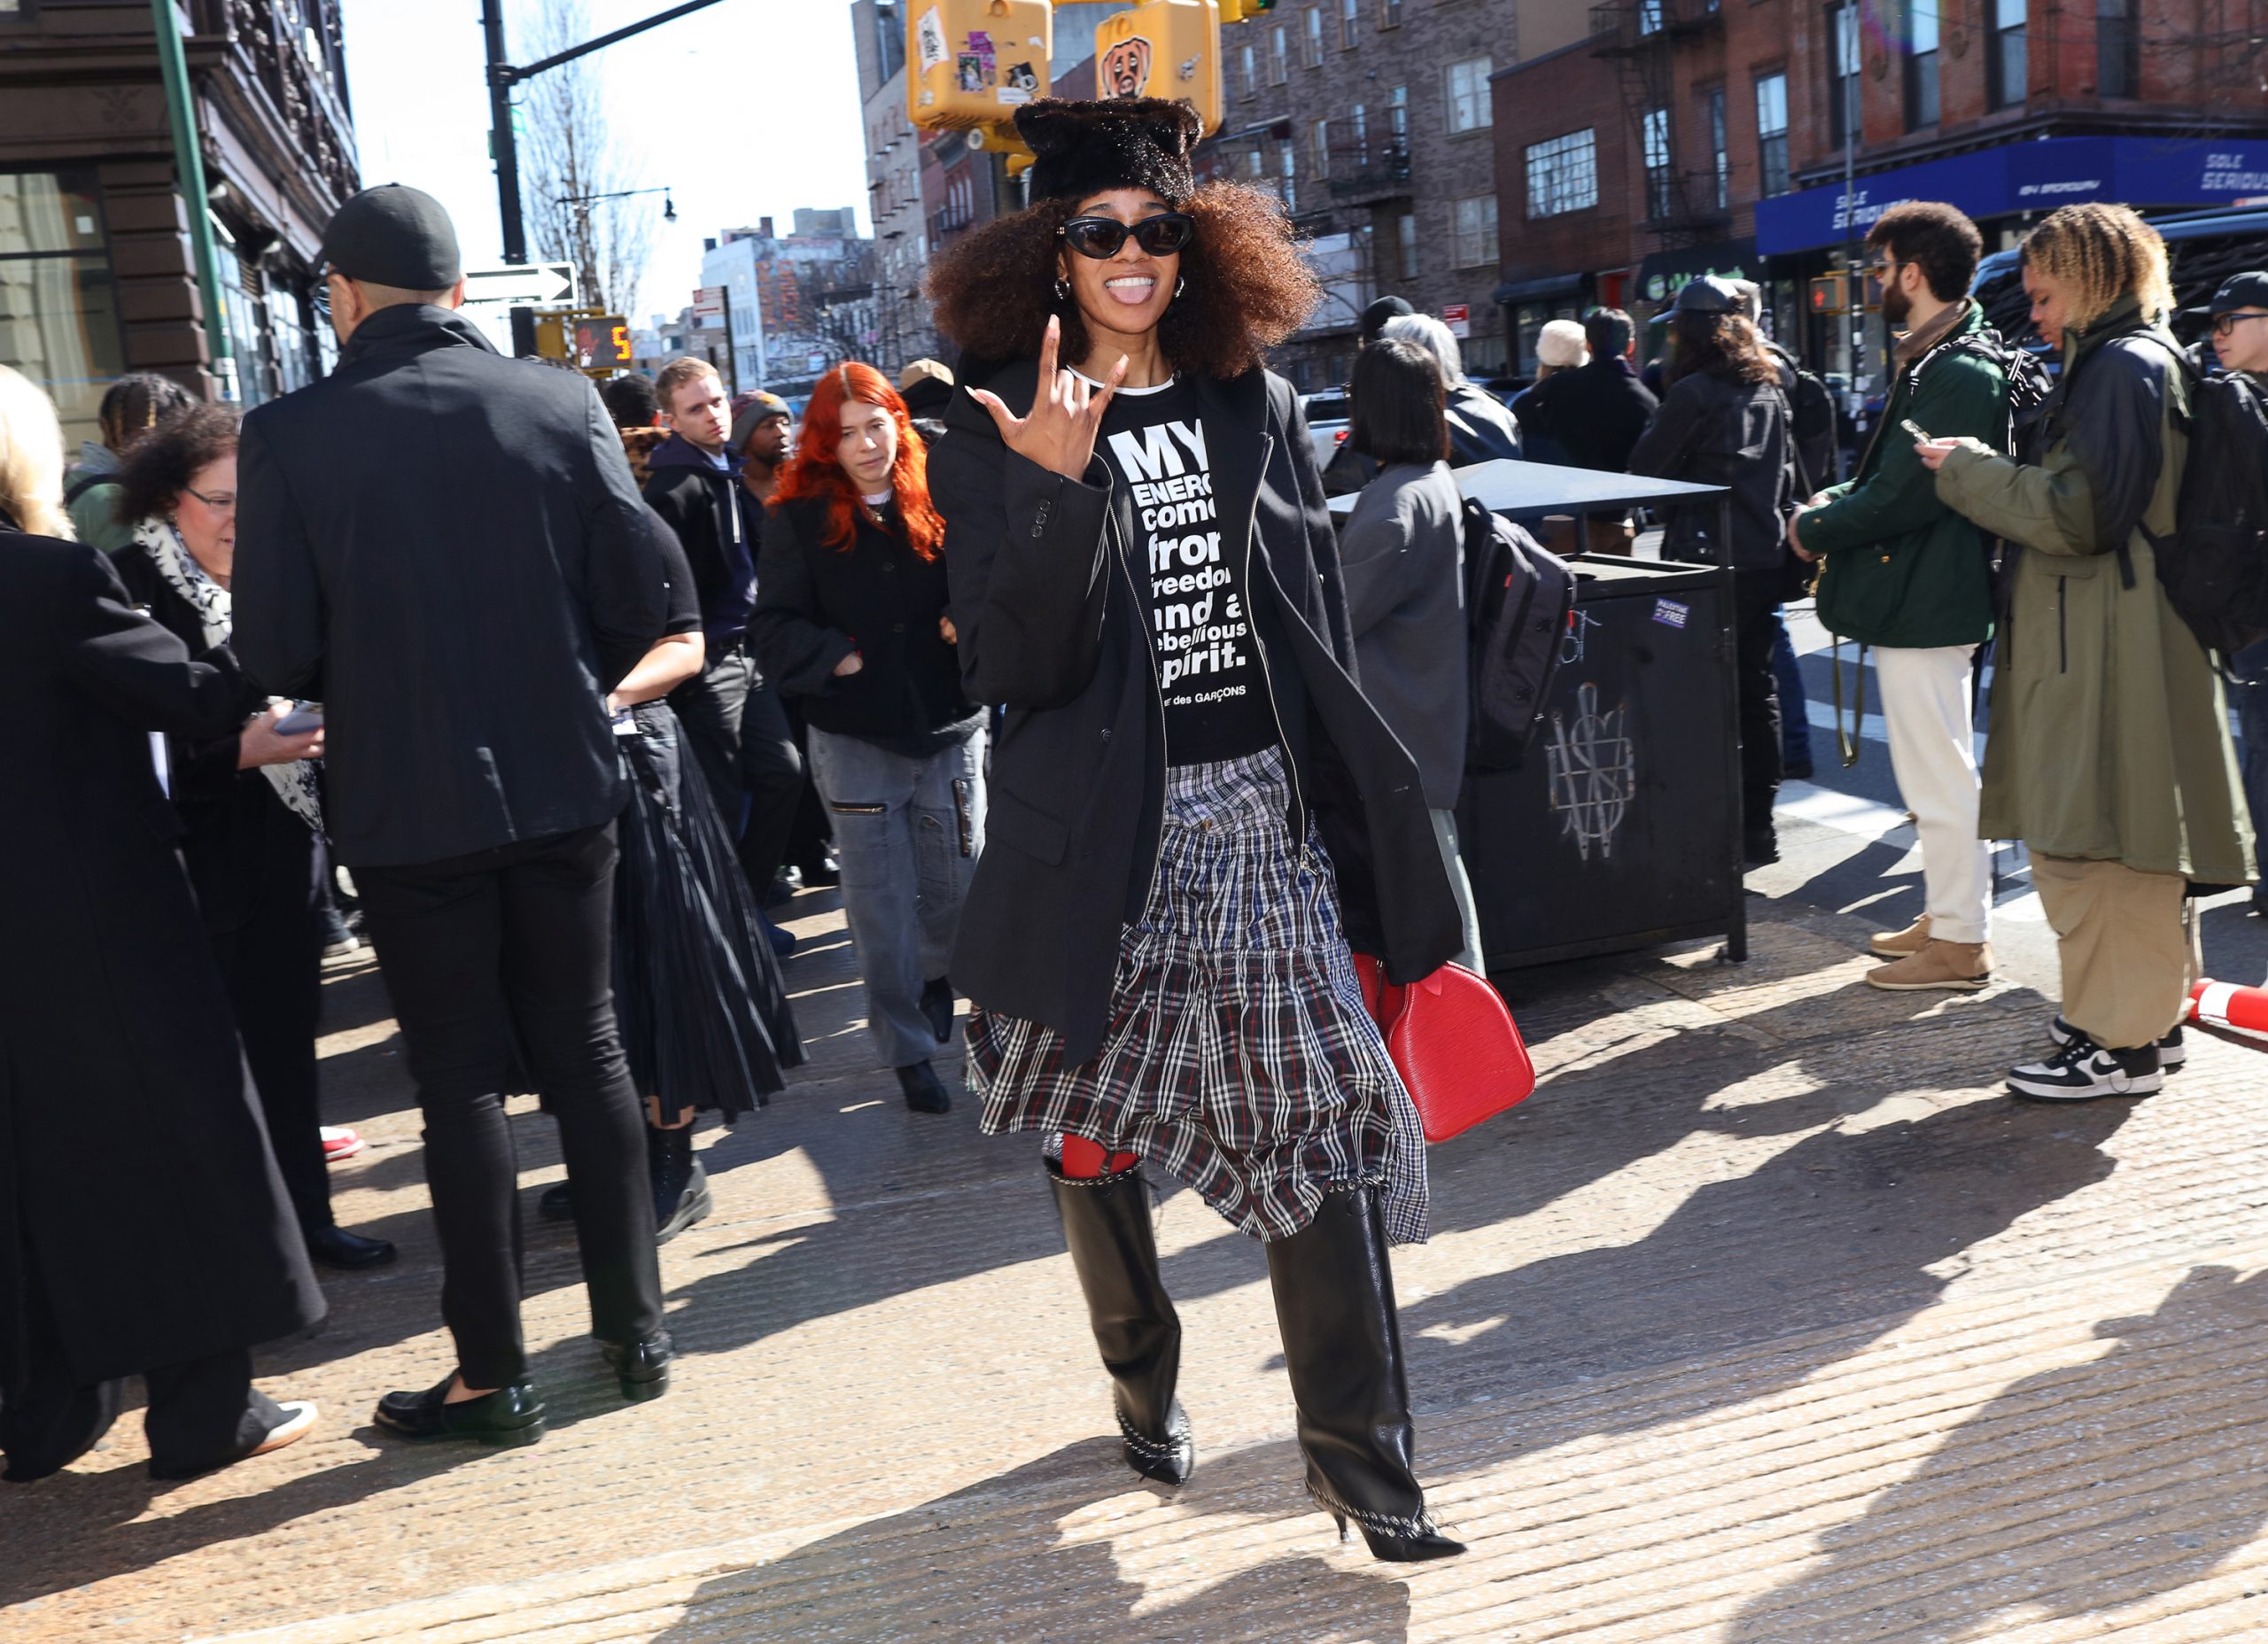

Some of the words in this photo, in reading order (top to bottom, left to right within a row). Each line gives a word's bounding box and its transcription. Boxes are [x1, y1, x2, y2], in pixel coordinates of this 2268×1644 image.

[2205, 153, 2244, 169] SOLE
[1835, 190, 1868, 210] SLE
[611, 325, 633, 361] 5
[1107, 418, 1209, 484] MY
[1151, 565, 1231, 600] reedo
[1665, 610, 1687, 624] FREE
[1160, 640, 1247, 689] pirit.
[1173, 694, 1192, 705] des
[1194, 685, 1247, 703] GARÇONS
